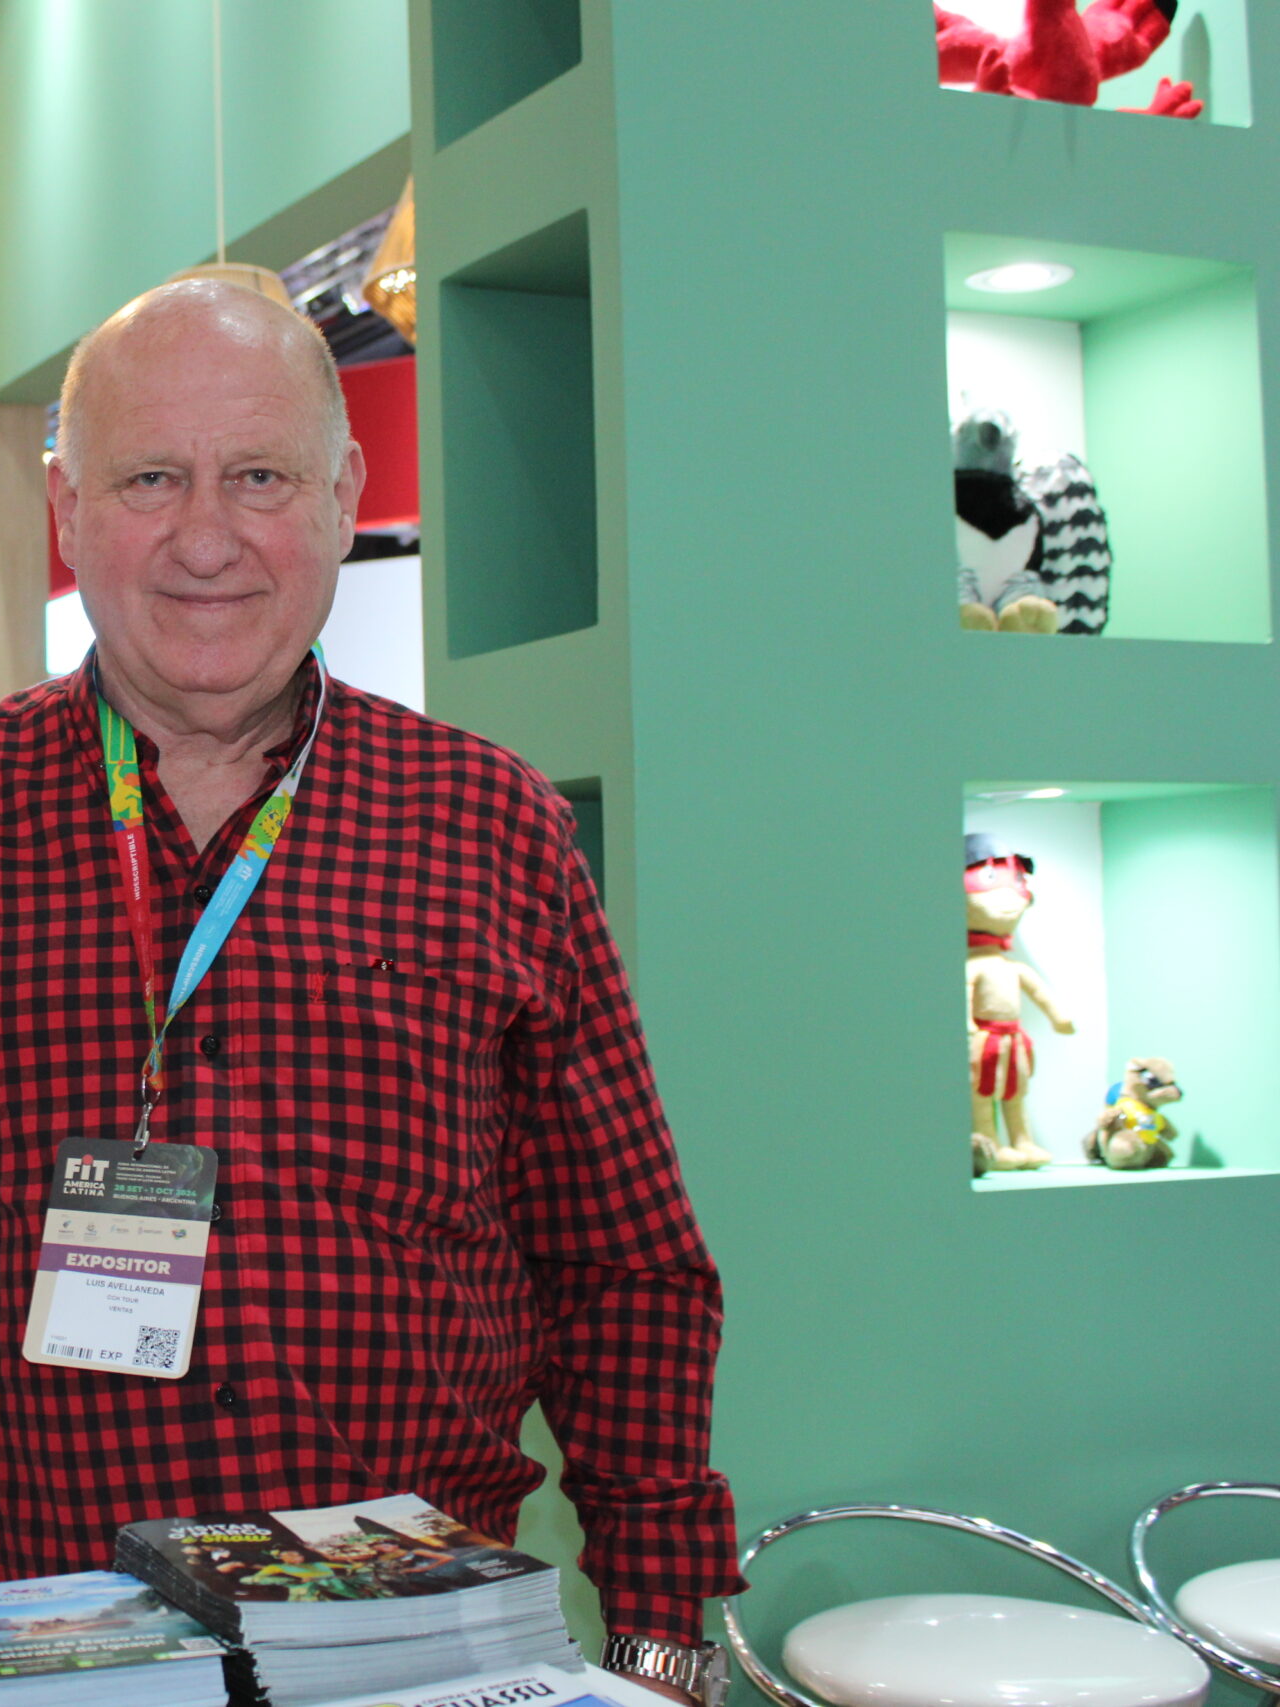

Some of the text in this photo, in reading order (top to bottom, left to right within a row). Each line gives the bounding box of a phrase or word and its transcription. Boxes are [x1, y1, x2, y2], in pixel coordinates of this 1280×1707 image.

[63, 1181, 105, 1191] AMERICA
[156, 1187, 174, 1195] OCT
[63, 1187, 104, 1197] LATINA
[66, 1253, 171, 1275] EXPOSITOR
[86, 1279, 165, 1296] LUIS AVELLANEDA
[100, 1349, 123, 1361] EXP
